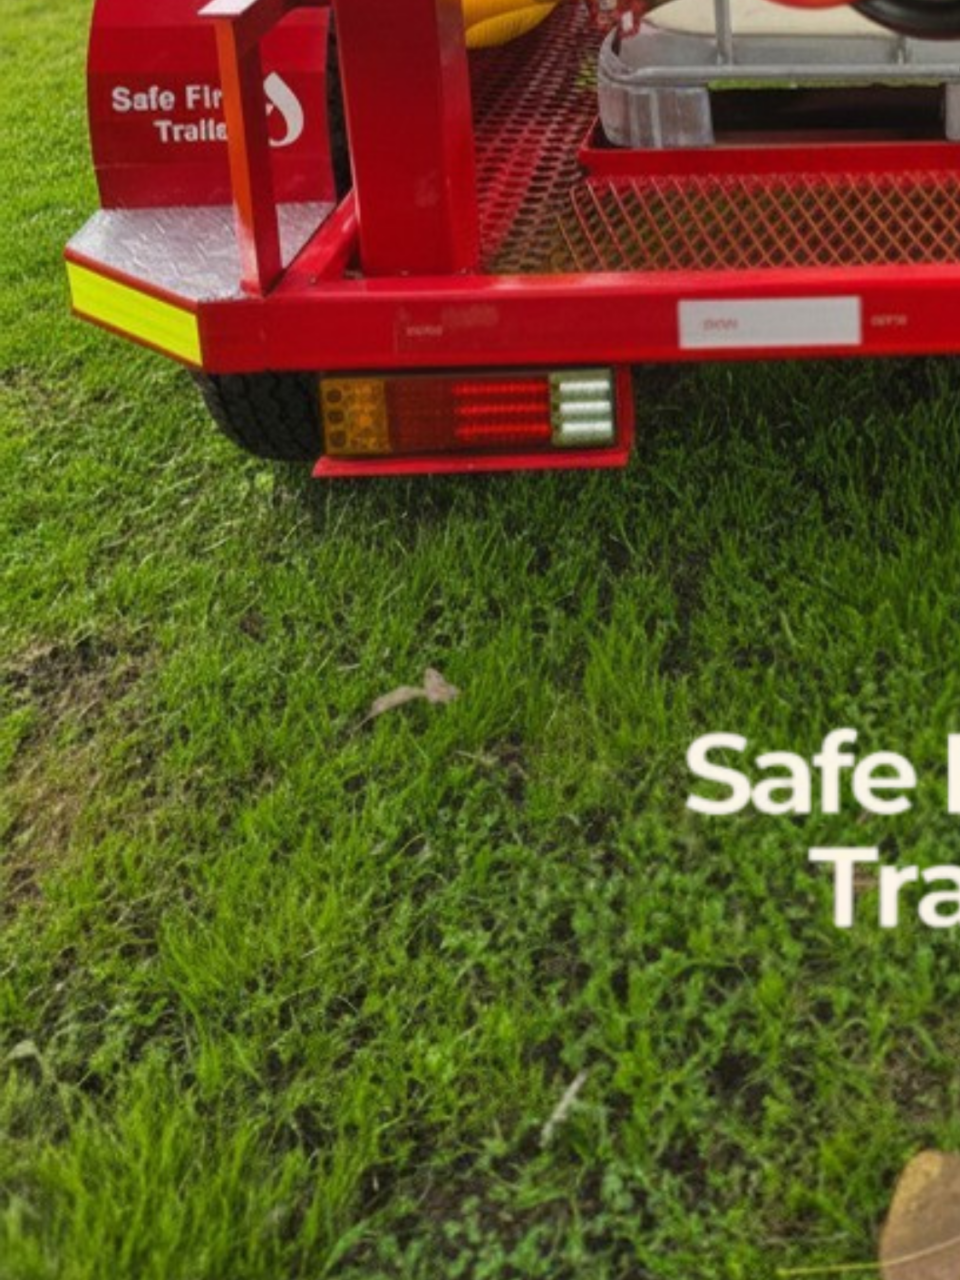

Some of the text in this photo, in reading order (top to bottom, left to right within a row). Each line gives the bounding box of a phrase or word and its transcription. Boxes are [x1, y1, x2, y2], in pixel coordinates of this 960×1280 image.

[111, 85, 223, 111] Safe Fir
[153, 118, 228, 142] Traile
